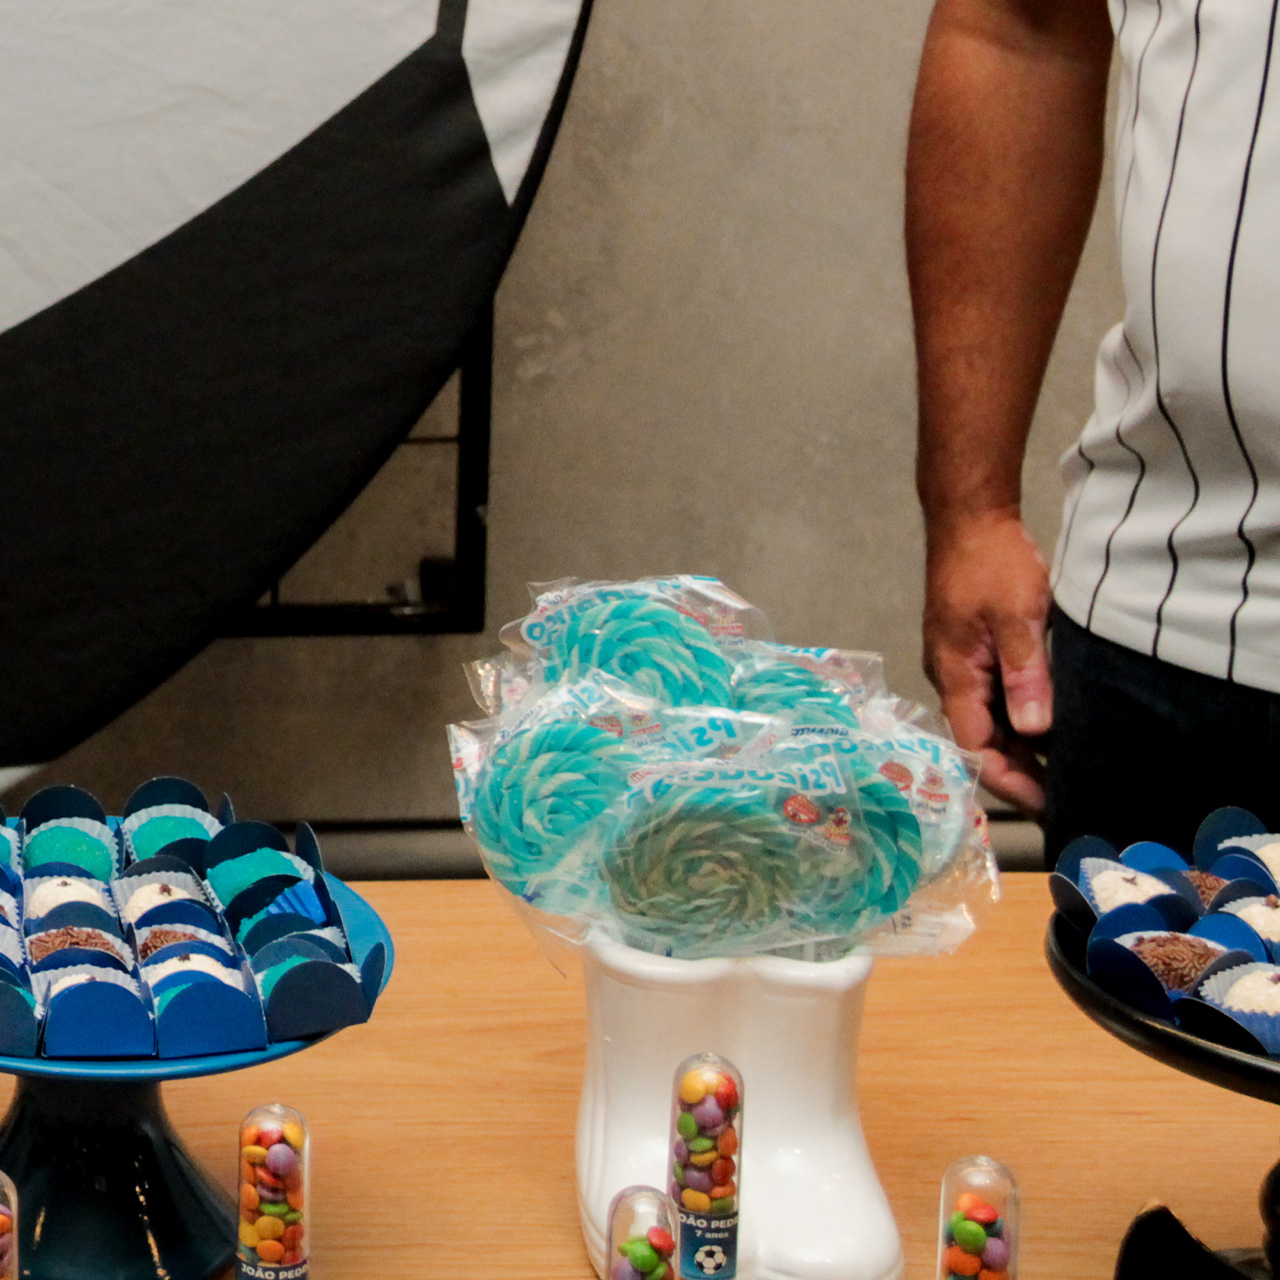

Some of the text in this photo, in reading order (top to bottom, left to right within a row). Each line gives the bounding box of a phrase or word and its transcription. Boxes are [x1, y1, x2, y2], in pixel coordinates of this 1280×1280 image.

[694, 1228, 730, 1239] 7 anos
[240, 1263, 276, 1280] JOÃO
